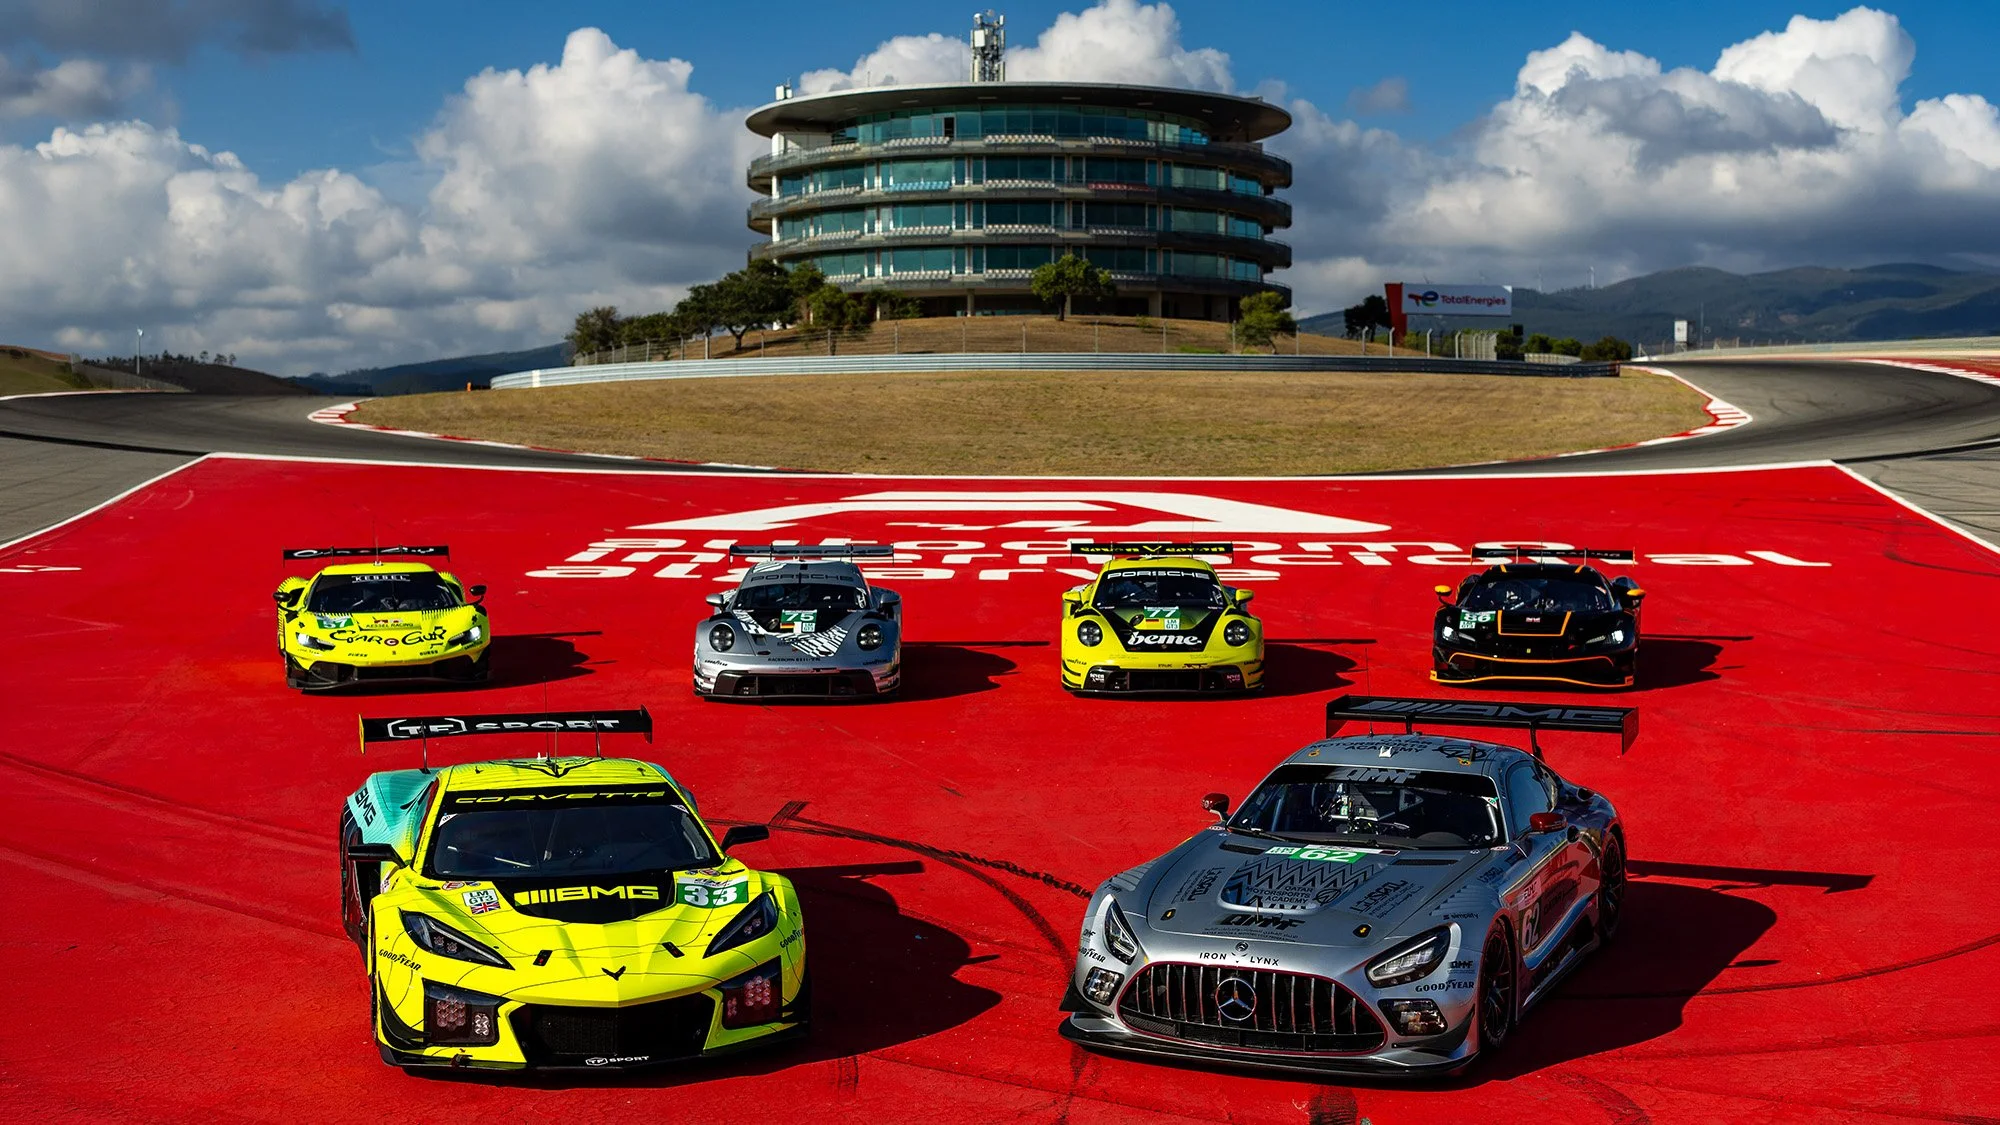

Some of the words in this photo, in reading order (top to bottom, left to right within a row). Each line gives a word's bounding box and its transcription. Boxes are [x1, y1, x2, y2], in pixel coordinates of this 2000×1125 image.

[1441, 294, 1506, 307] TotalEnergies
[750, 574, 854, 583] PORSCHE
[1107, 570, 1210, 580] PORSCHE
[785, 612, 815, 622] 75
[1147, 608, 1178, 617] 77
[1463, 613, 1491, 622] 86
[475, 719, 620, 730] SPORT
[455, 791, 665, 804] CORVETTE
[354, 786, 377, 828] BMG
[1299, 850, 1357, 862] 62
[469, 890, 489, 898] LM
[556, 885, 659, 902] BMG
[1246, 886, 1311, 899] MOTORSPORTS
[1284, 885, 1313, 893] QATAR
[468, 895, 494, 905] GT3
[683, 885, 738, 906] 33
[1265, 895, 1308, 904] ACADEMY
[1521, 902, 1540, 951] 62
[378, 948, 422, 971] GOODYEAR
[1200, 952, 1227, 960] IRON
[1249, 955, 1279, 966] LYNX
[1415, 979, 1475, 992] GOODYEAR
